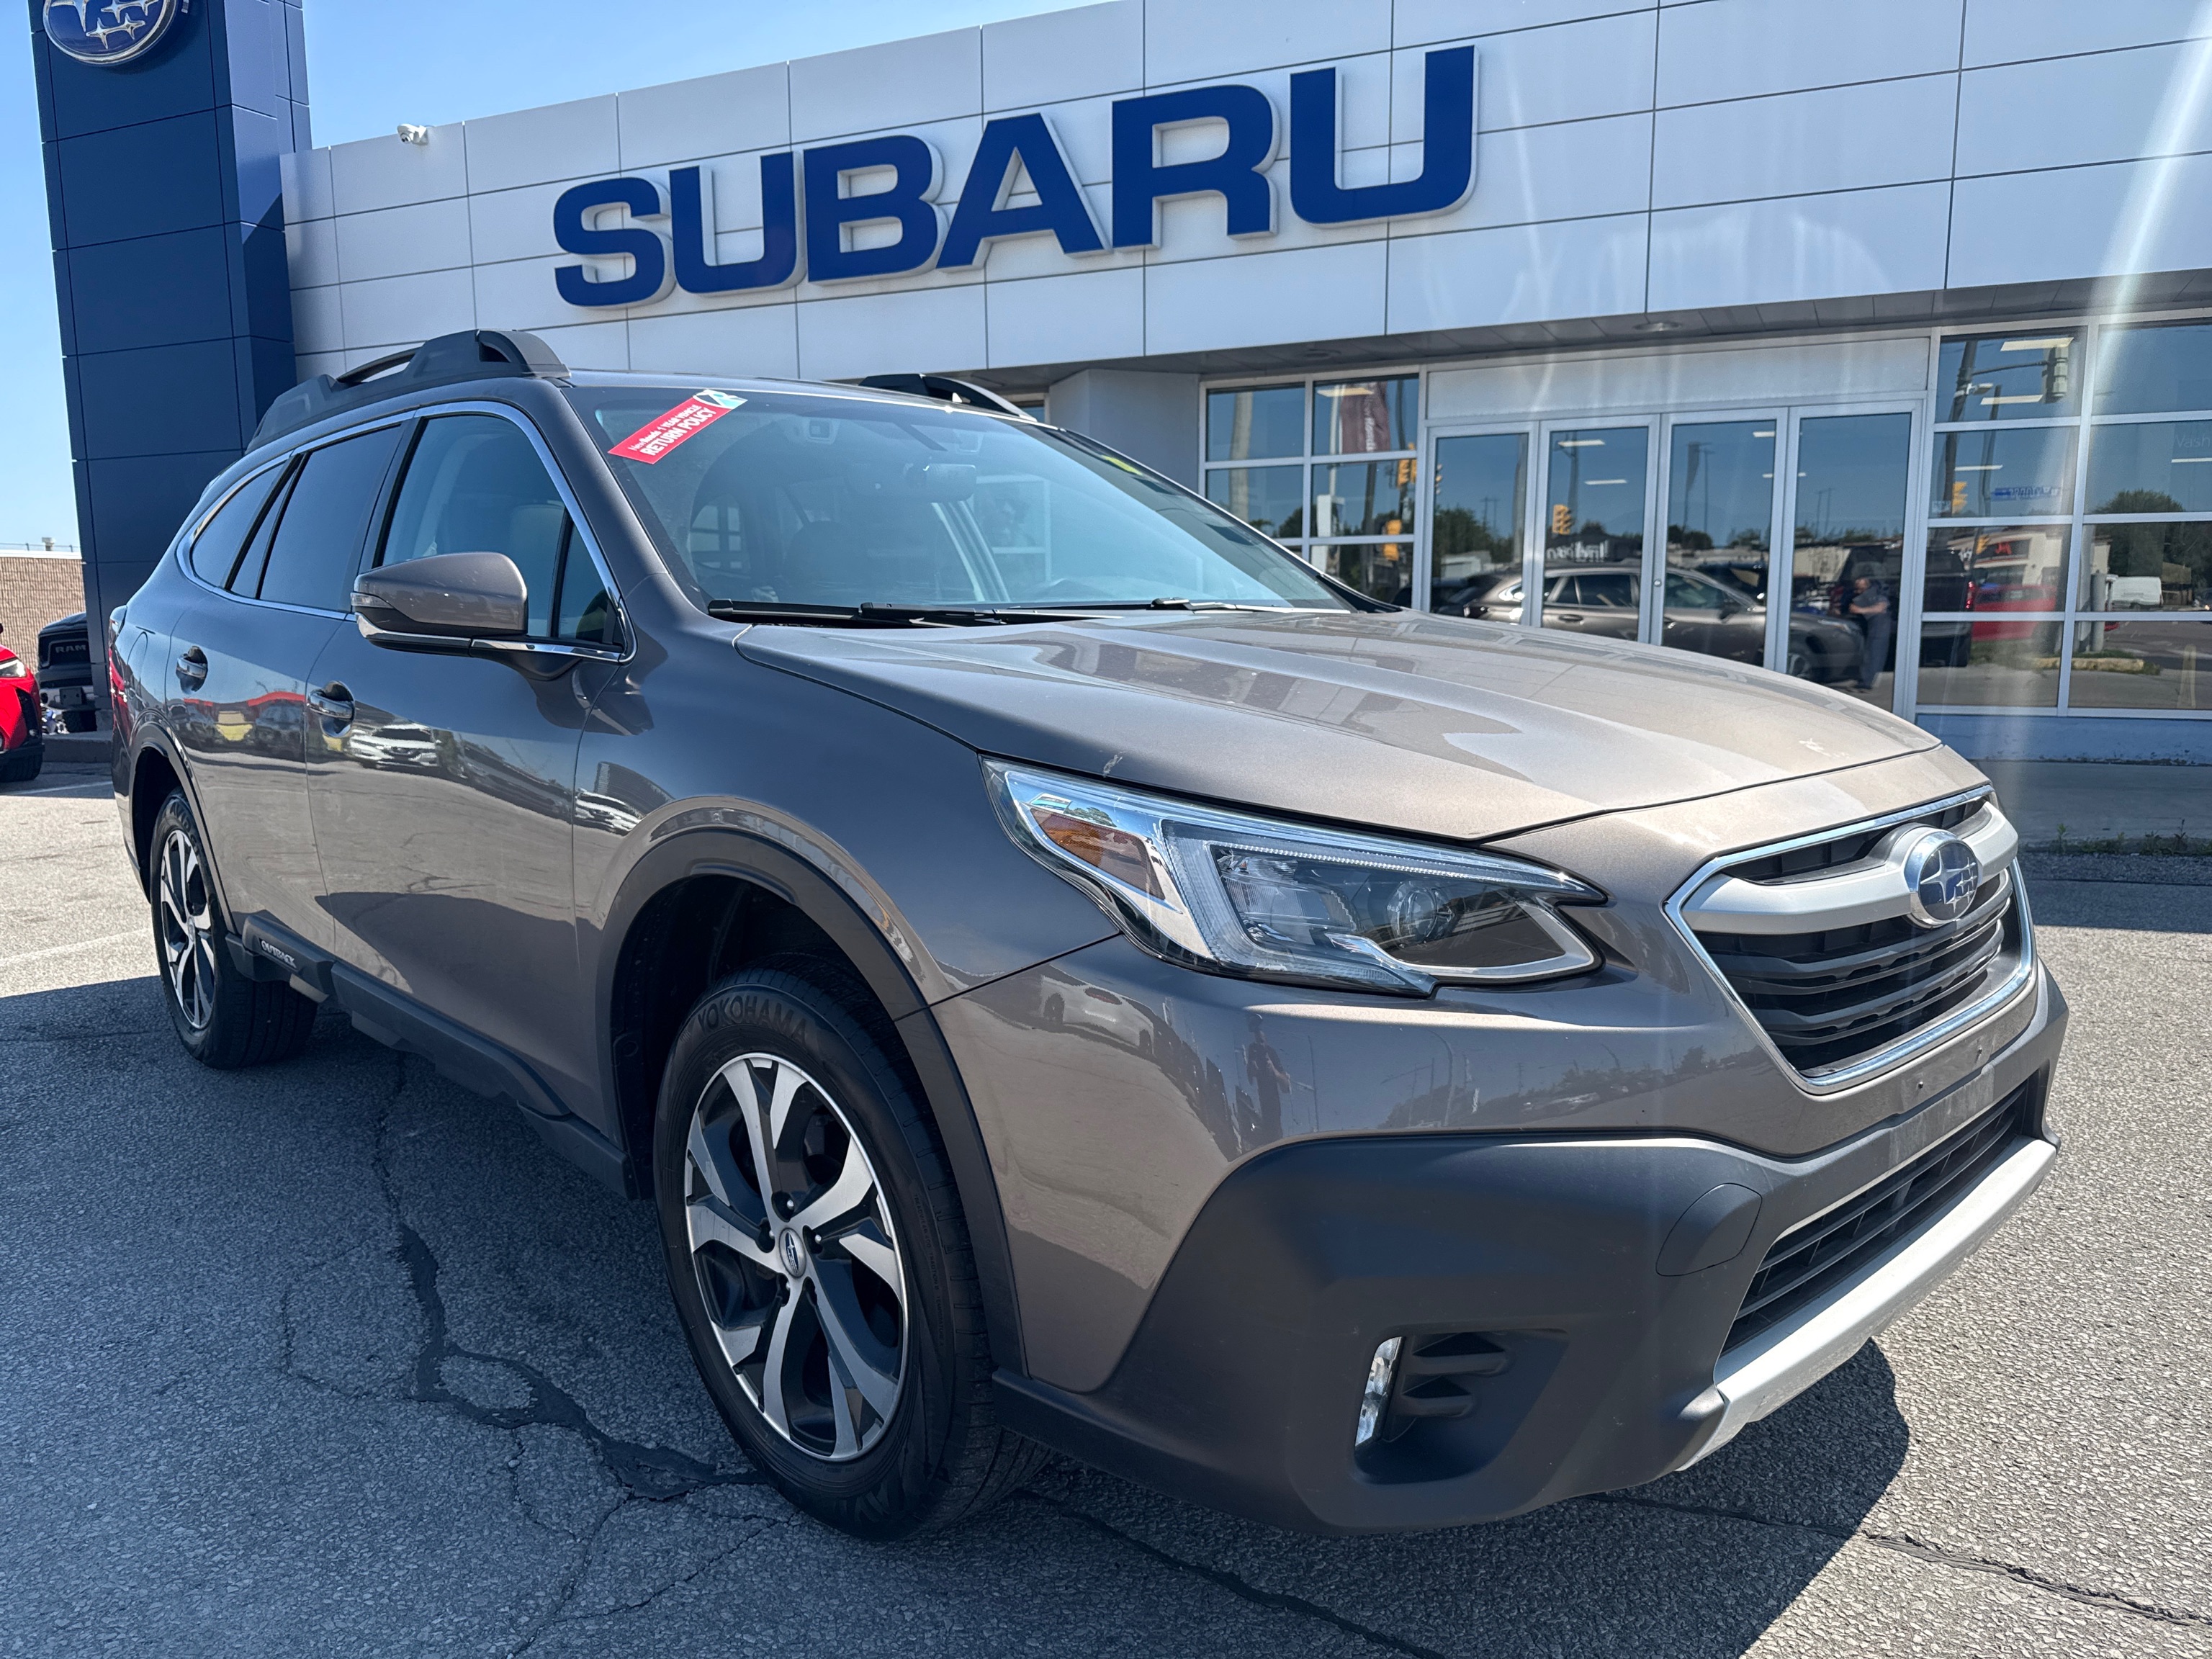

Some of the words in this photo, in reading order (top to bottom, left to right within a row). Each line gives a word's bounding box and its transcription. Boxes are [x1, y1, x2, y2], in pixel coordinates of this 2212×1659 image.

[552, 45, 1478, 307] SUBARU
[639, 427, 688, 456] RETURN
[677, 407, 716, 430] POLICY
[660, 417, 681, 428] YEAR
[675, 404, 702, 418] VEHICLE
[55, 644, 86, 653] RAM
[261, 940, 297, 968] OUTBACK
[697, 995, 806, 1044] YOKOHAMA
